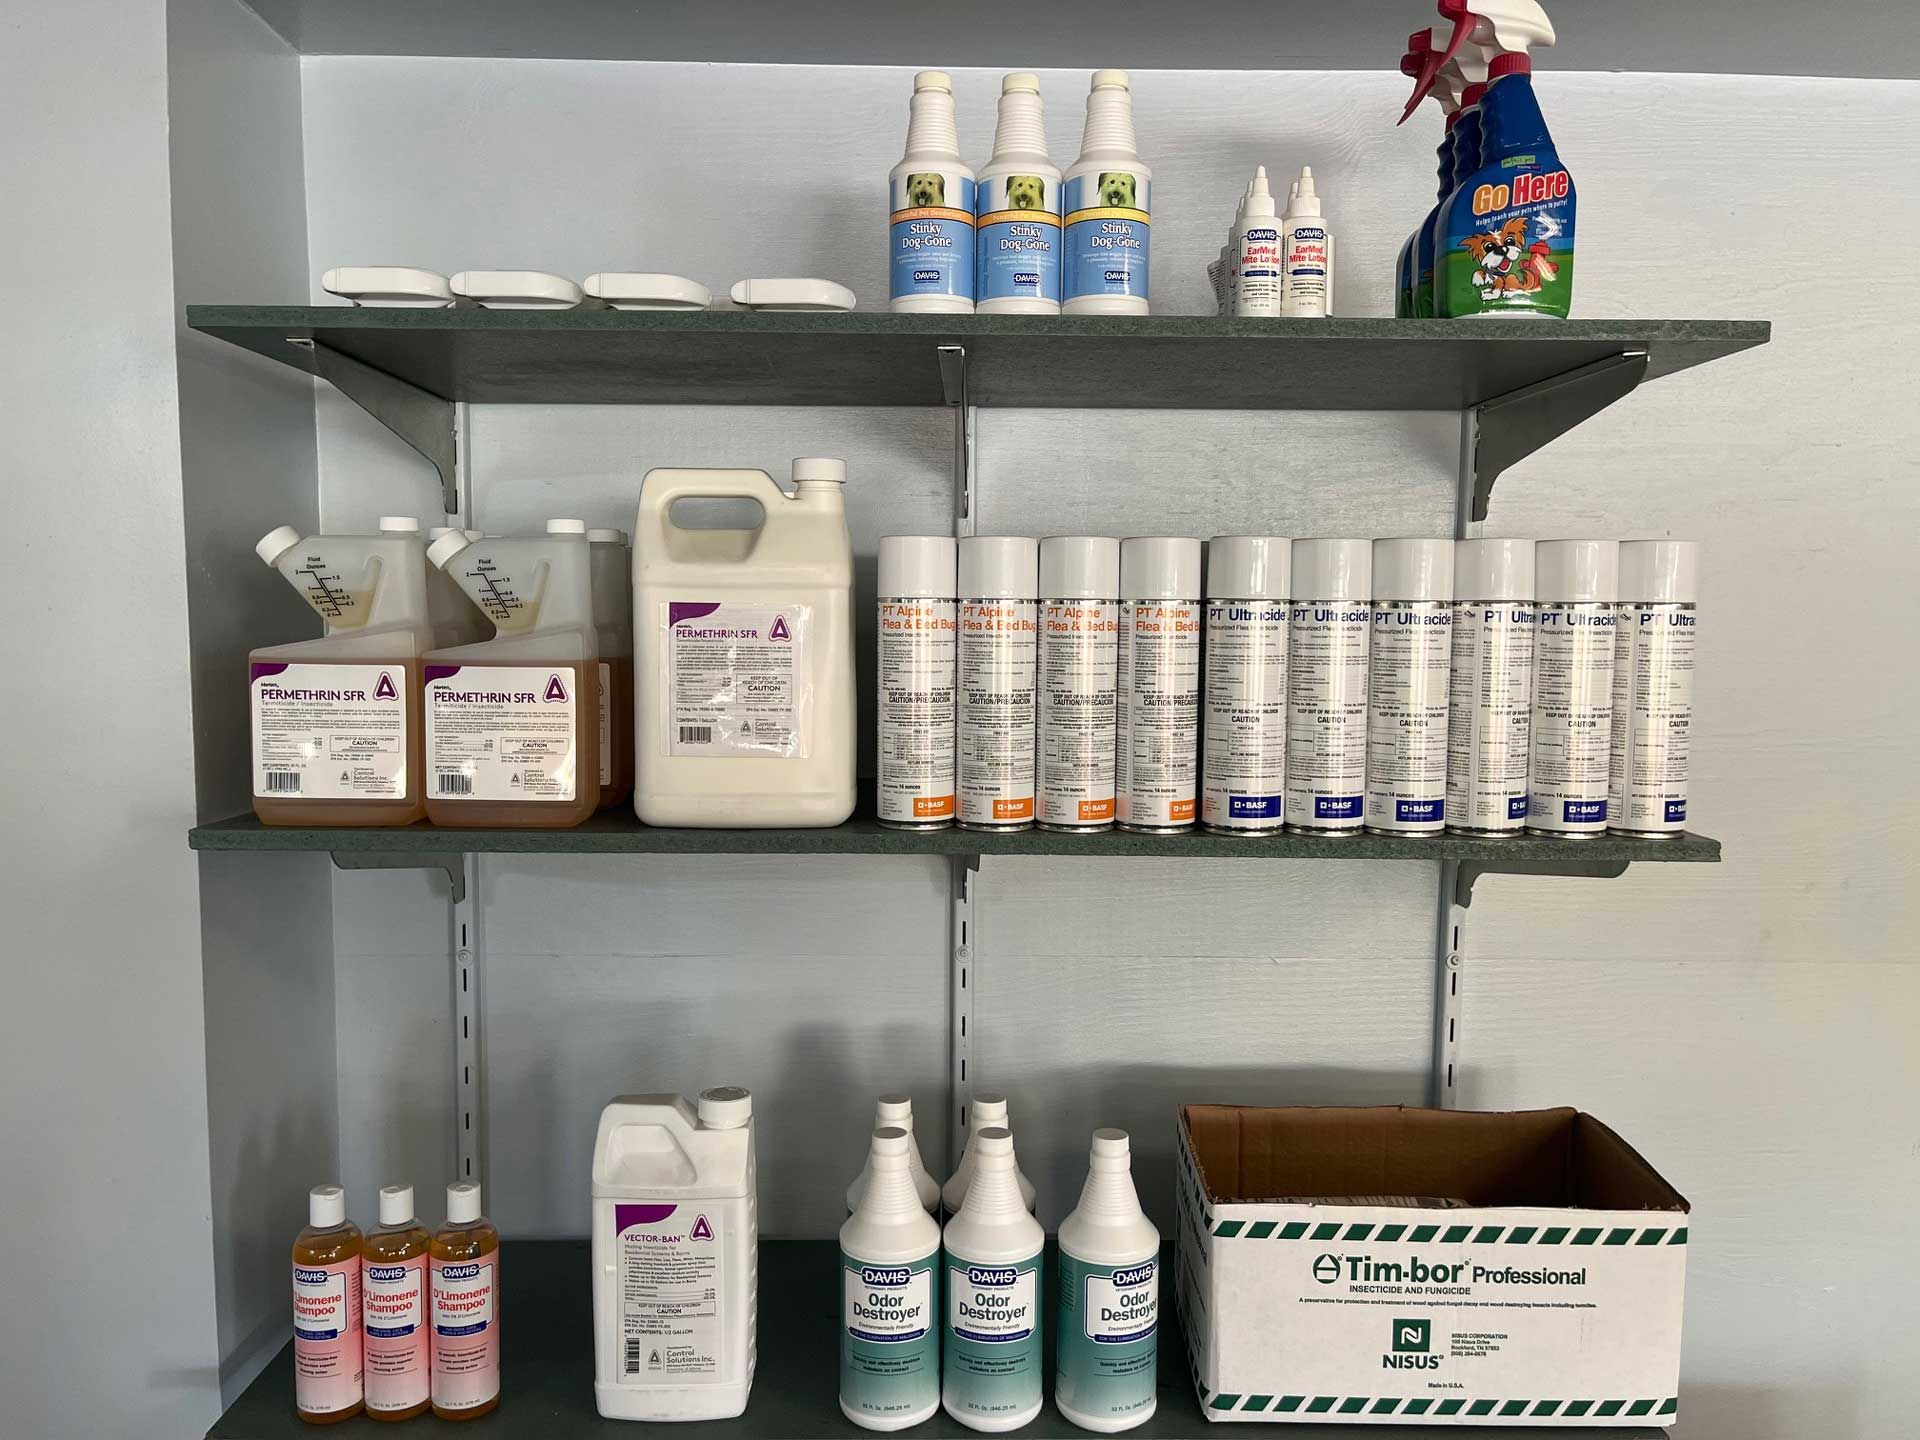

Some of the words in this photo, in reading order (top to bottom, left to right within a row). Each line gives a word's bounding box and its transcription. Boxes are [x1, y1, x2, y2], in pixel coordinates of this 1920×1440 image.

[1512, 171, 1568, 207] Here
[1476, 217, 1490, 226] Helps
[1492, 213, 1507, 222] teach
[1508, 210, 1519, 218] your
[1522, 207, 1532, 216] pets
[1554, 199, 1567, 208] potty!
[911, 222, 941, 235] Stinky
[1010, 225, 1042, 239] Stinky
[1102, 223, 1132, 236] Stinky
[1297, 229, 1323, 238] DAVIS
[1249, 231, 1276, 239] DAVIS
[903, 236, 951, 249] Dog-Gone
[1000, 238, 1050, 252] Dog-Gone
[1092, 237, 1140, 249] Dog-Gone
[1248, 247, 1276, 255] EarMed
[1242, 255, 1257, 264] Mite
[1261, 255, 1280, 263] Loion
[1289, 254, 1306, 262] Mite
[1308, 254, 1327, 262] Lotion
[1015, 274, 1038, 282] DAVIS
[883, 606, 894, 616] PT
[964, 607, 976, 616] PT
[1047, 608, 1060, 617] PT
[1064, 608, 1100, 620] Alpne
[1136, 608, 1151, 617] PT
[1210, 609, 1223, 620] PT
[1294, 610, 1307, 621] PT
[1485, 611, 1502, 622] PT
[883, 619, 901, 629] Flea
[904, 619, 912, 629] &
[916, 619, 937, 629] Bed
[1375, 613, 1391, 624] PT
[1542, 614, 1559, 625] PT
[964, 620, 981, 630] Flea
[985, 621, 993, 630] &
[997, 620, 1019, 630] Bed
[1047, 621, 1068, 631] Flea
[1072, 621, 1080, 631] &
[1136, 622, 1159, 631] Flea
[1176, 622, 1193, 631] Bed
[677, 630, 738, 638] PERMETHRIN
[741, 630, 757, 638] SFR
[262, 689, 340, 700] PERMETHRIN
[344, 691, 366, 700] SFR
[434, 692, 511, 703] PERMETHRIN
[514, 693, 536, 703] SFR
[296, 1270, 325, 1281] DAVIS
[371, 1268, 402, 1278] DAVIS
[444, 1266, 476, 1276] DAVIS
[1117, 1266, 1152, 1284] DAVIS
[1346, 1255, 1464, 1283] Tim-bor
[1473, 1266, 1586, 1285] Professional
[865, 1271, 907, 1284] DAVIS
[972, 1271, 1013, 1284] DAVIS
[434, 1286, 490, 1300] D'Limonene
[1350, 1285, 1402, 1293] INSECTICIDE
[1405, 1286, 1422, 1294] AND
[1425, 1286, 1471, 1295] FUNGICIDE
[438, 1298, 486, 1312] Shampoo
[869, 1293, 904, 1307] Odor
[975, 1293, 1010, 1307] Odor
[1120, 1291, 1149, 1308] Odor
[366, 1301, 412, 1314] Shampoo
[854, 1301, 921, 1323] Destroyer
[960, 1301, 1027, 1323] Destroyer
[859, 1322, 894, 1331] Environmentally
[1383, 1355, 1439, 1369] NISUS
